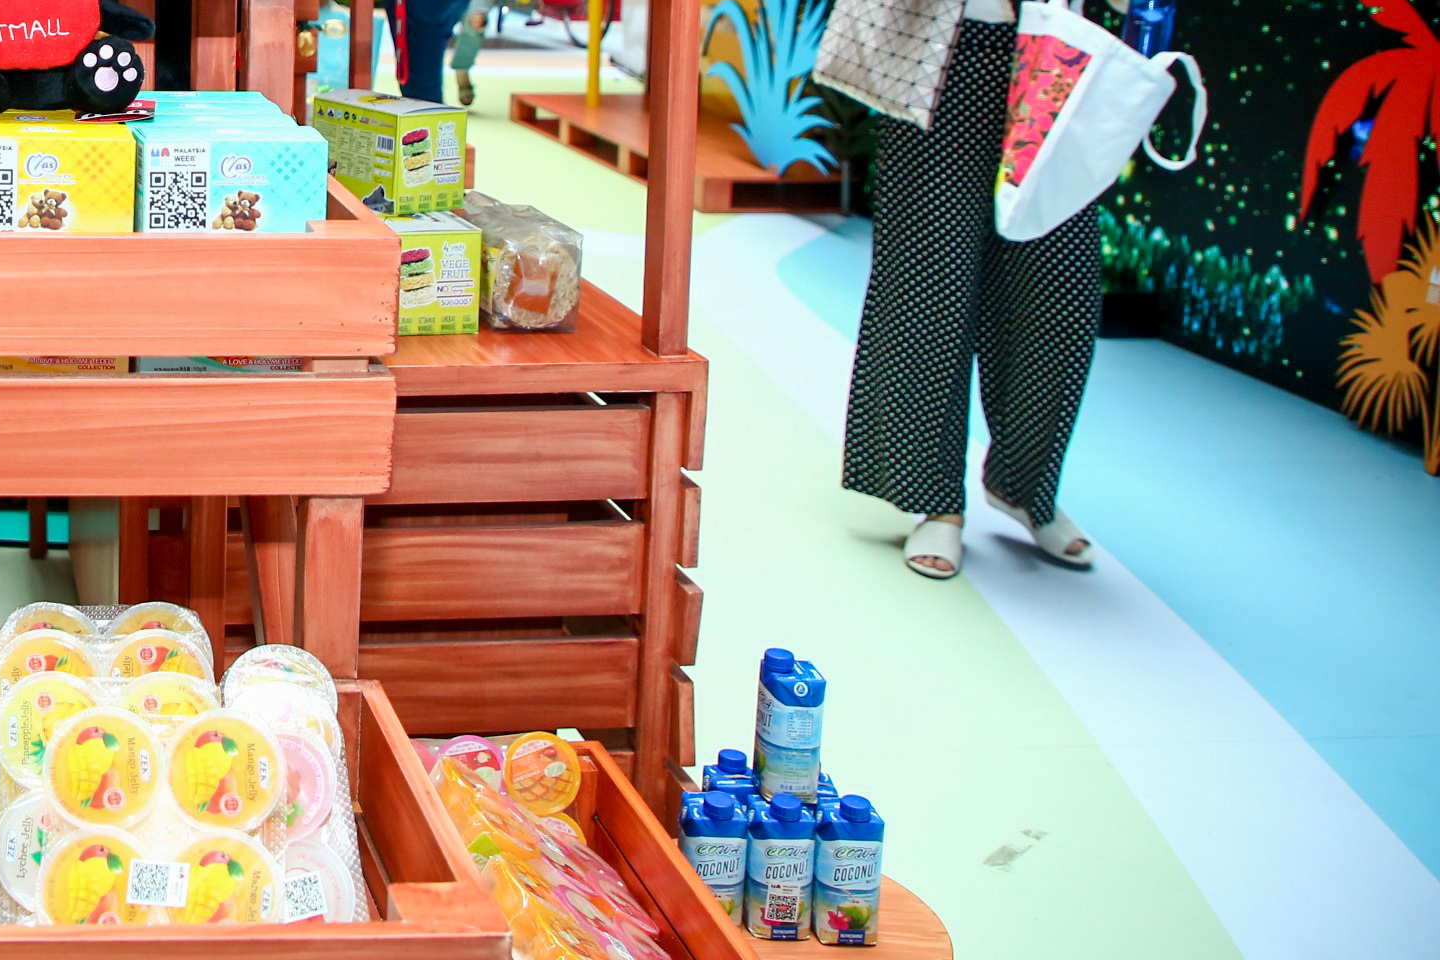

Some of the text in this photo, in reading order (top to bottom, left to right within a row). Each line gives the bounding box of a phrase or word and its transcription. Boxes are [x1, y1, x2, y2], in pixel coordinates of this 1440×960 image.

[441, 259, 469, 269] VEGE
[441, 269, 470, 279] FRUIT
[436, 285, 449, 293] NO
[127, 737, 140, 795] Mango Jelly
[140, 753, 149, 775] ZEK
[246, 743, 260, 801] Mango Jelly
[259, 760, 268, 781] ZEK
[6, 836, 16, 858] ZEK
[16, 815, 34, 879] Lychee Jelly
[695, 843, 740, 856] COWA
[765, 845, 811, 859] COWA
[833, 846, 877, 860] COWA
[696, 857, 740, 878] COCONUT
[765, 859, 809, 880] COCONUT
[833, 861, 877, 882] COCONUT
[262, 891, 272, 913] ZEK
